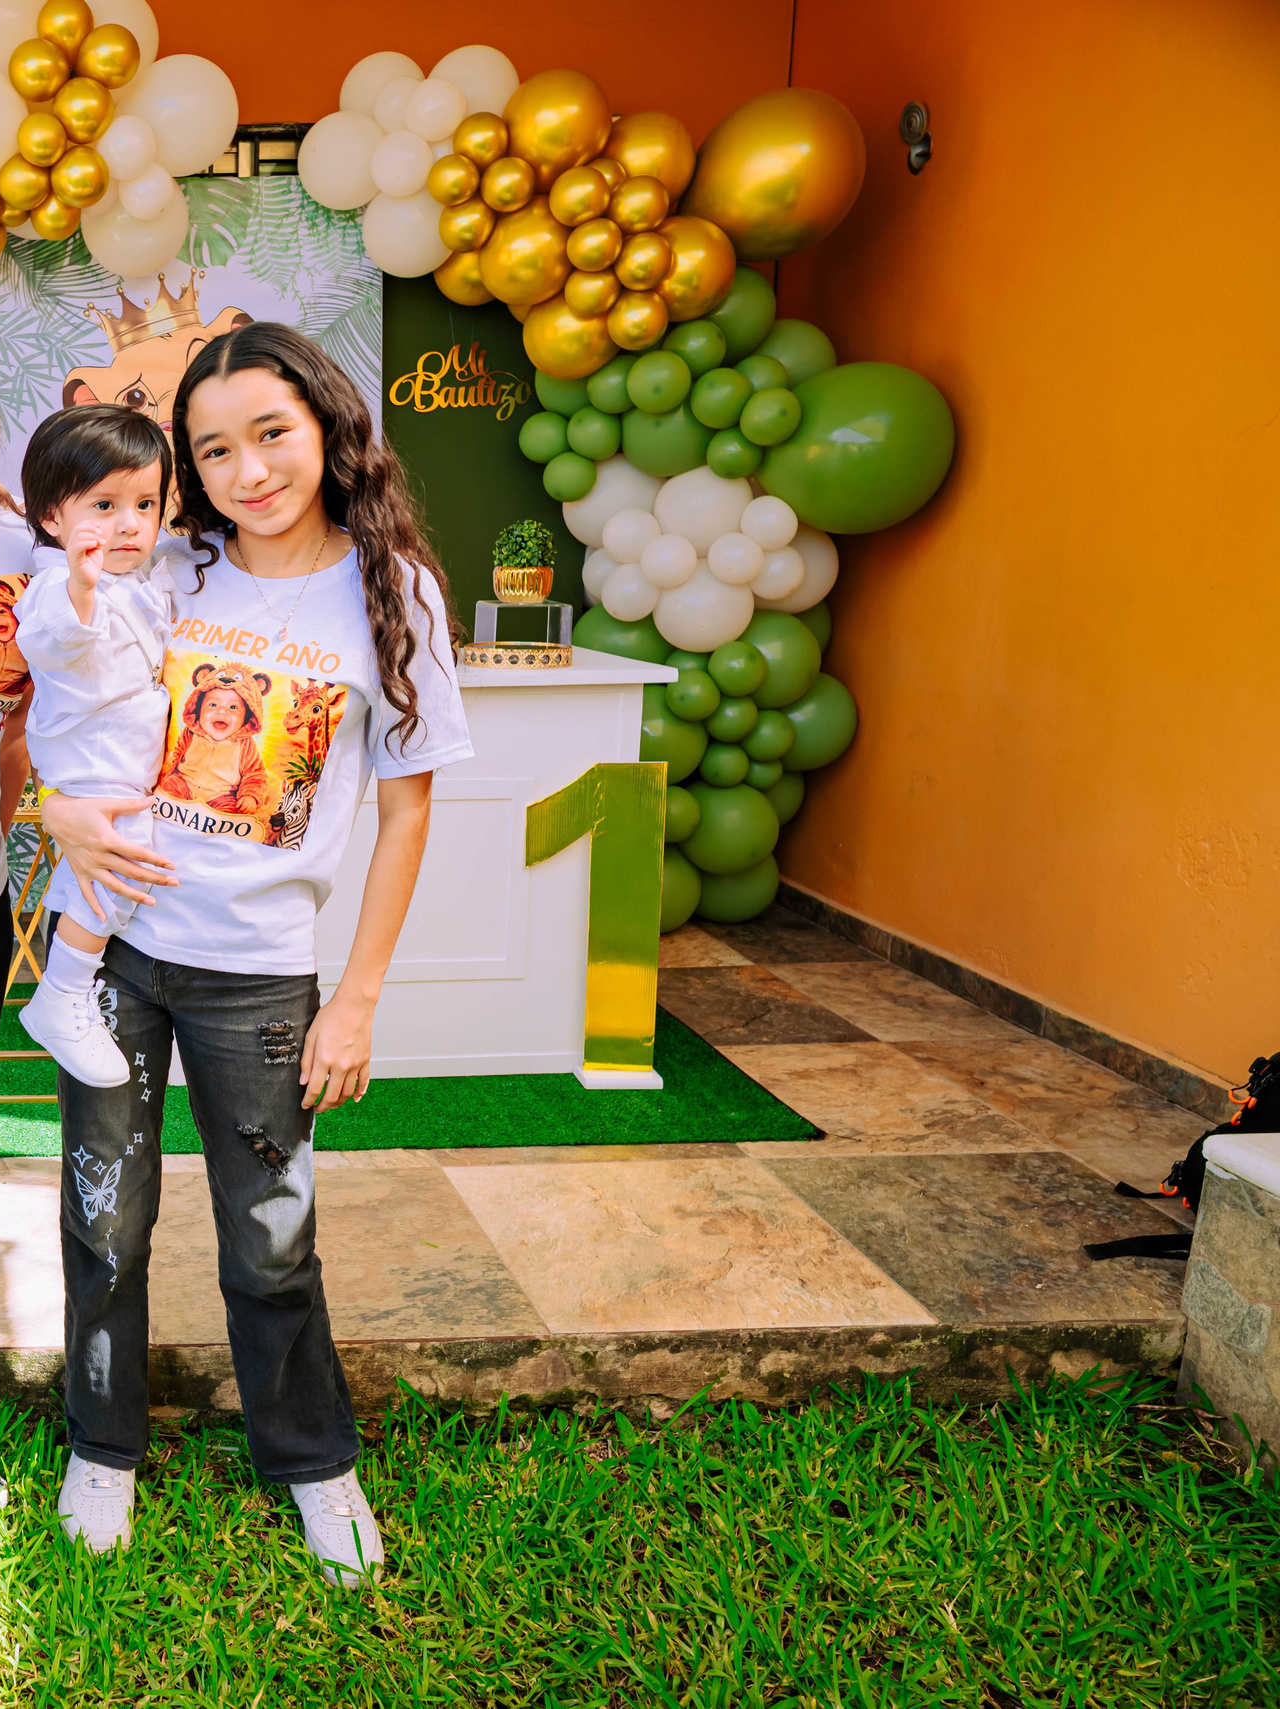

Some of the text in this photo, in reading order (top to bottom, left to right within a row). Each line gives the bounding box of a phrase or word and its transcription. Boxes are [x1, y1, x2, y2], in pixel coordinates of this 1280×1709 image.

[417, 341, 490, 382] Mi
[389, 371, 532, 421] Bautizo
[172, 617, 341, 674] PRIMER AÑO
[151, 797, 252, 837] EONARDO
[524, 761, 668, 1071] 1
